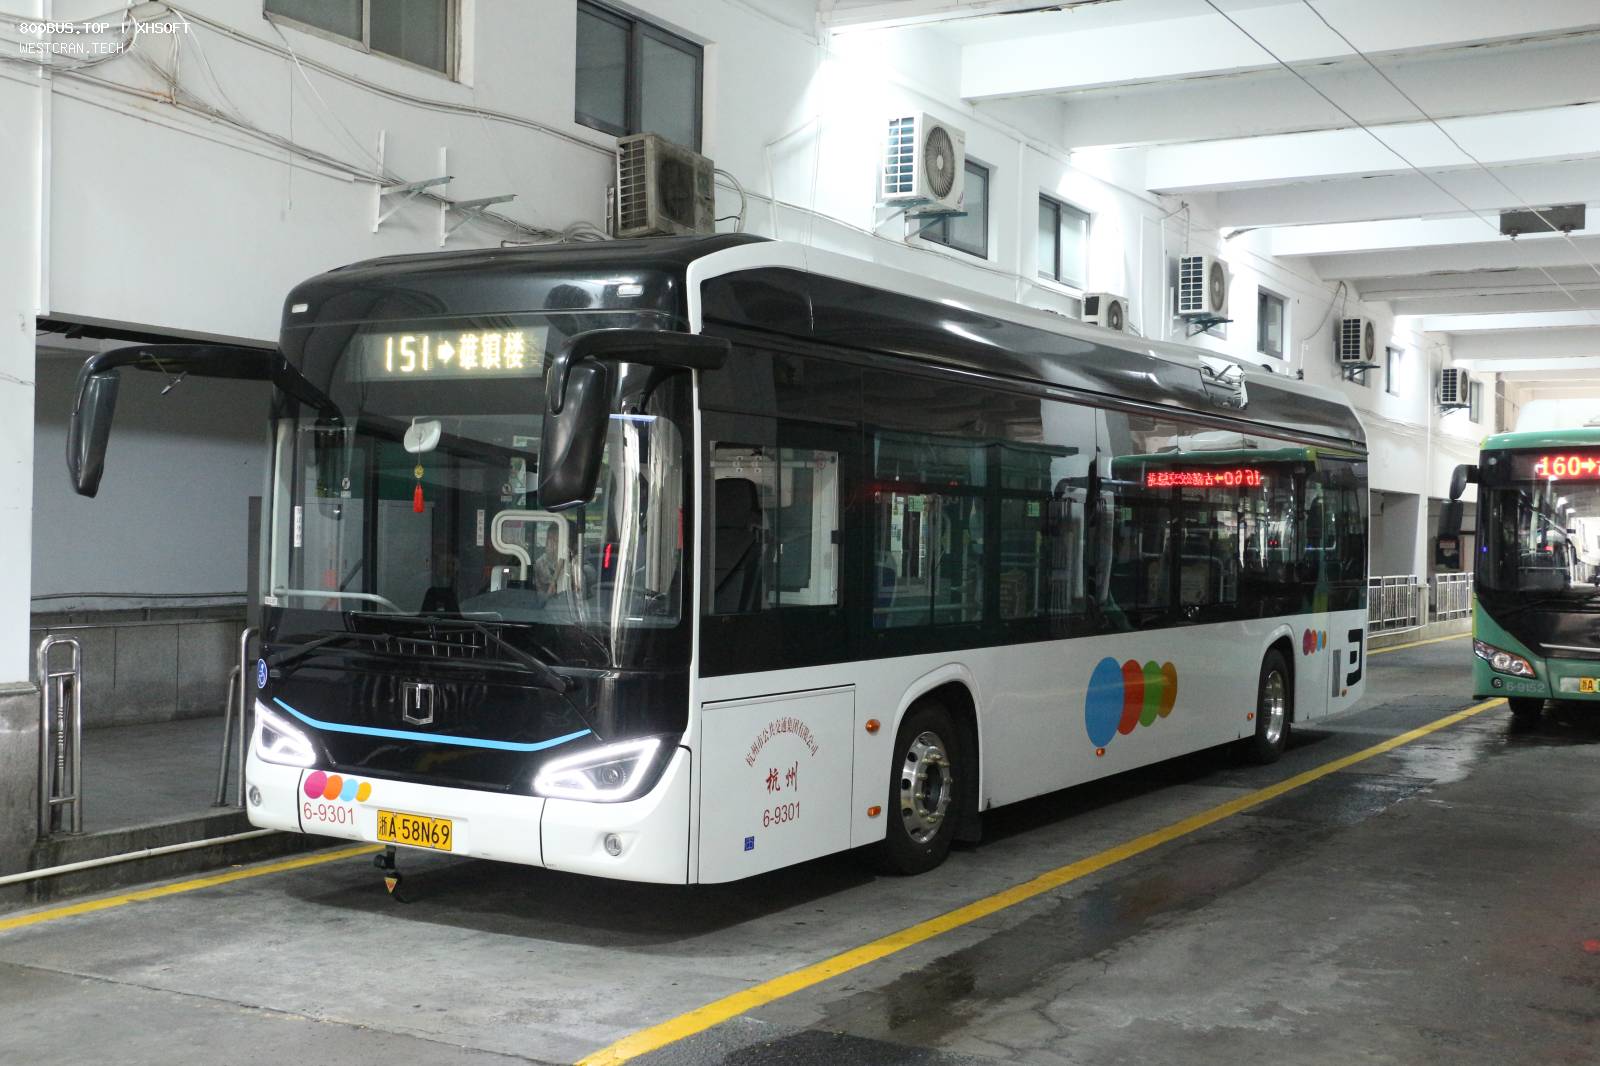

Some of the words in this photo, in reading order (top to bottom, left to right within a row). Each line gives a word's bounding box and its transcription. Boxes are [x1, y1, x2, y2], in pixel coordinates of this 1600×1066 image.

[385, 335, 429, 372] 151
[1539, 456, 1581, 476] 160
[765, 760, 799, 794] 杭州
[303, 802, 354, 825] 6-9301
[763, 801, 800, 828] 6-9301
